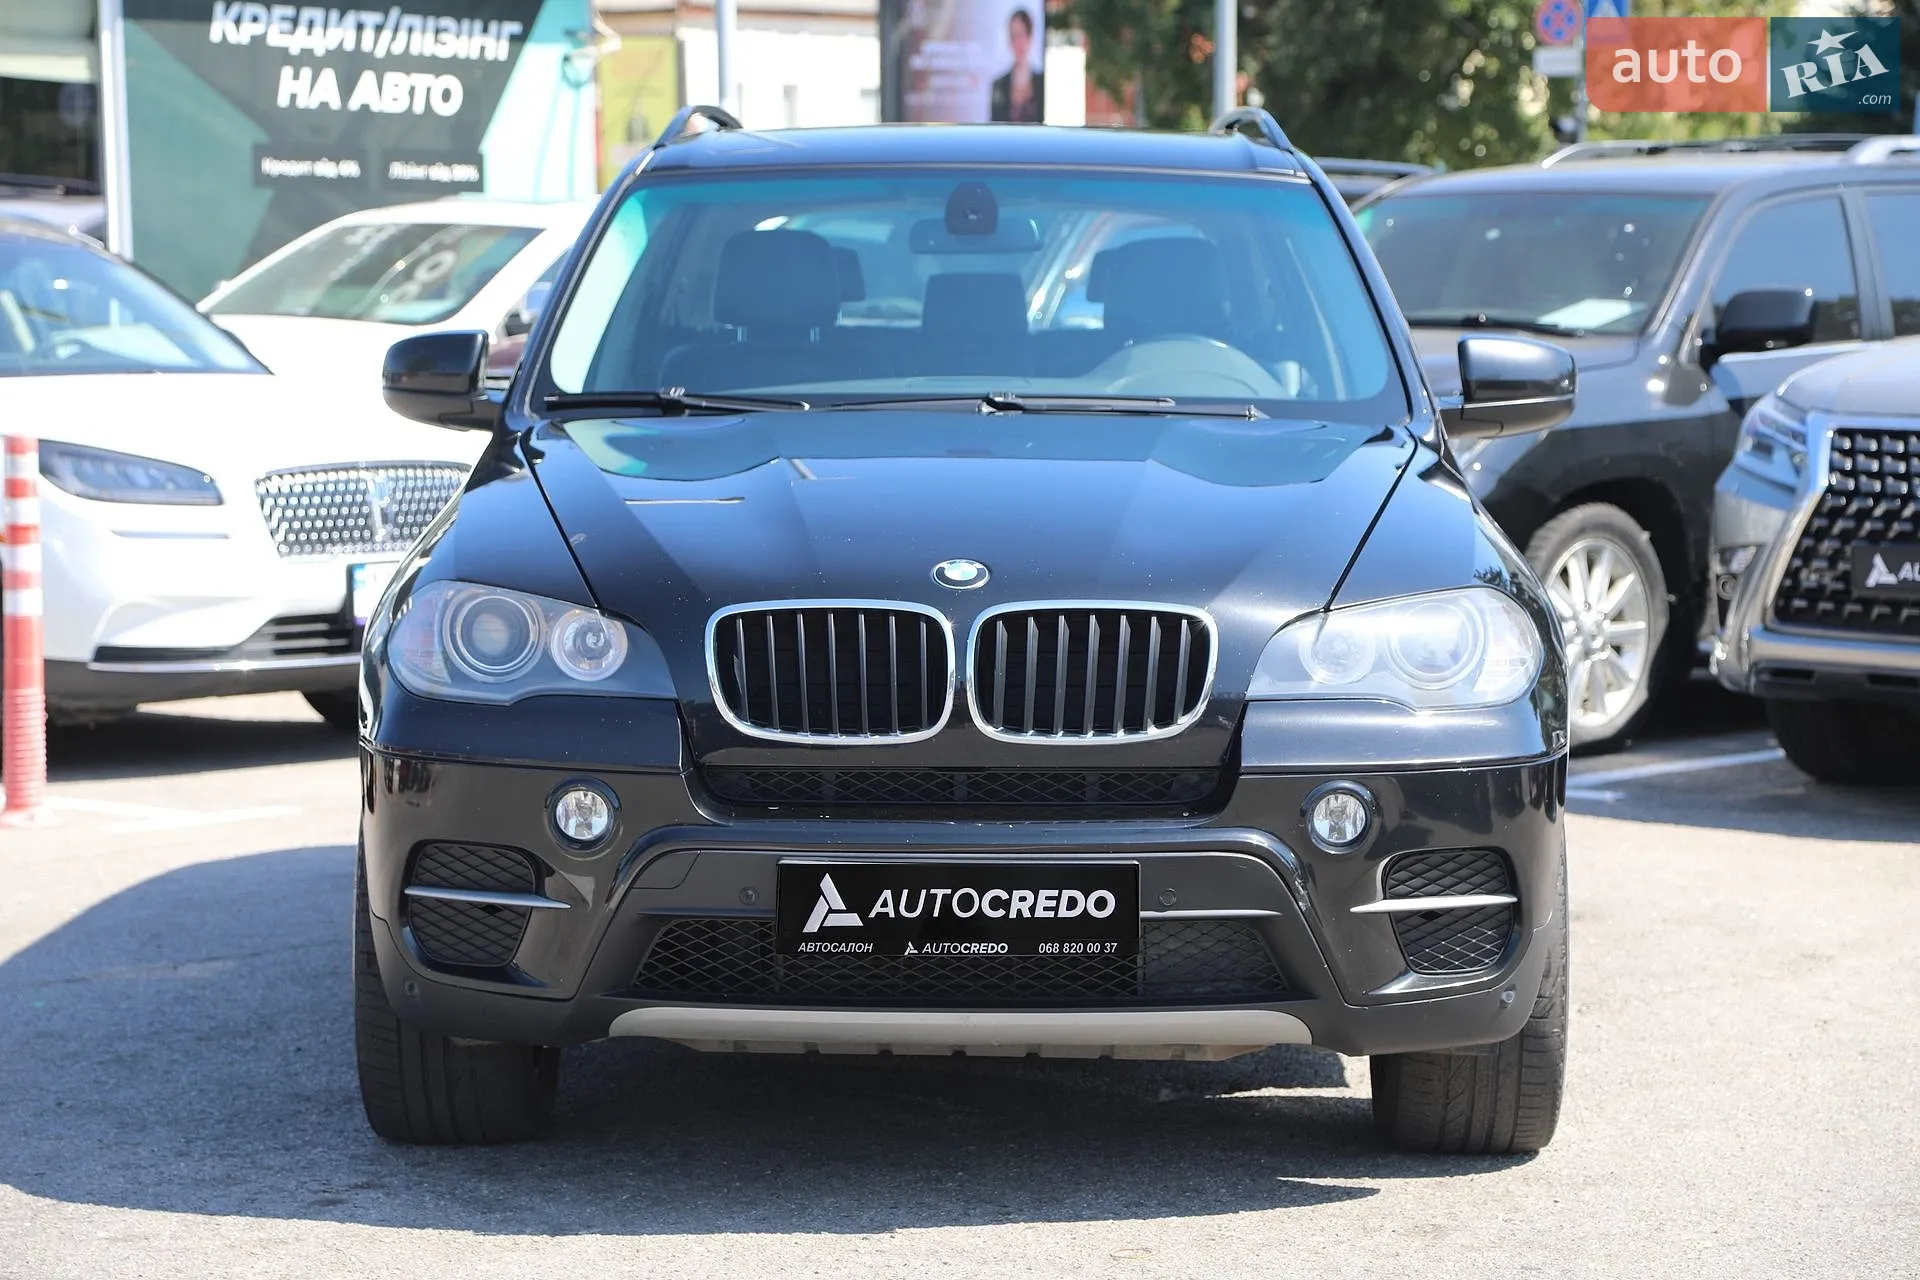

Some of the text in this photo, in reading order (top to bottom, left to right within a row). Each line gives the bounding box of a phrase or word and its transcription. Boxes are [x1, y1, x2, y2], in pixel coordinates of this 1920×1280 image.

[209, 0, 524, 62] КРЕДИТ/ЛІЗІНГ
[276, 65, 464, 118] НА АВТО
[868, 888, 1116, 919] AUTOCREDO
[797, 942, 873, 953] АВТОСАЛОН
[922, 942, 1009, 954] AUTOCREDO
[1038, 942, 1118, 954] 068 820 00 37
